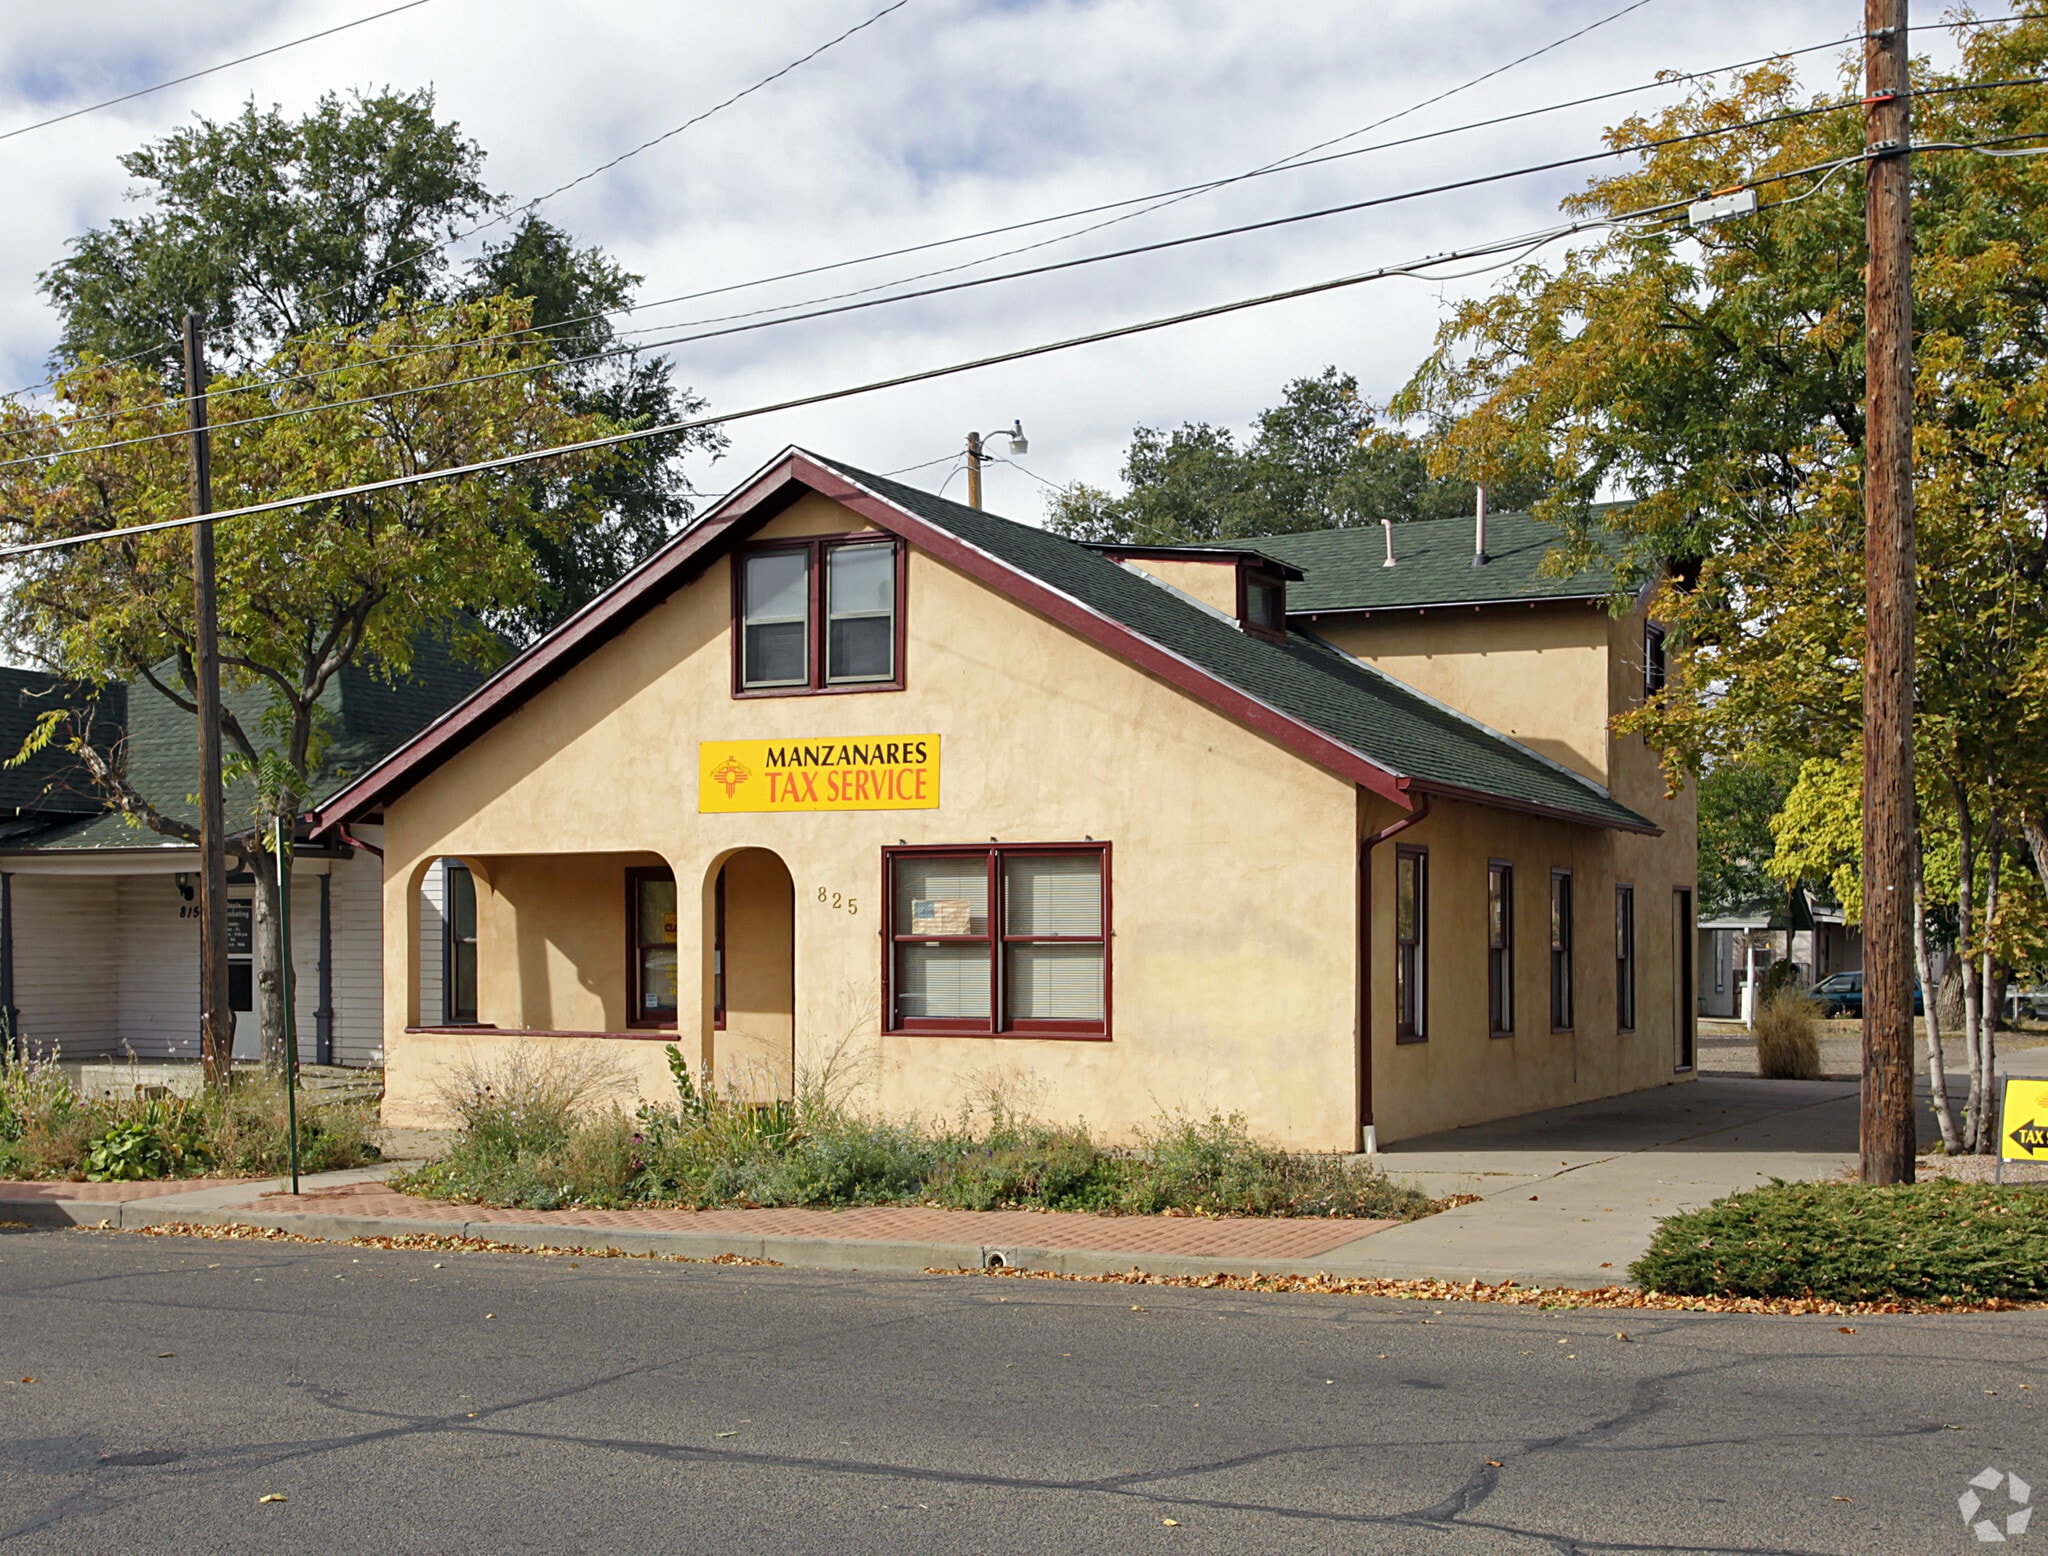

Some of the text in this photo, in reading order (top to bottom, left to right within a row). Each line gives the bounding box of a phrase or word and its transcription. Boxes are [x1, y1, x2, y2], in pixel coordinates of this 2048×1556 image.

[766, 742, 928, 768] MANZANARES
[765, 768, 928, 803] TAX SERVICE
[180, 906, 200, 918] 815
[818, 886, 858, 915] 825
[2019, 1129, 2045, 1145] TAX
